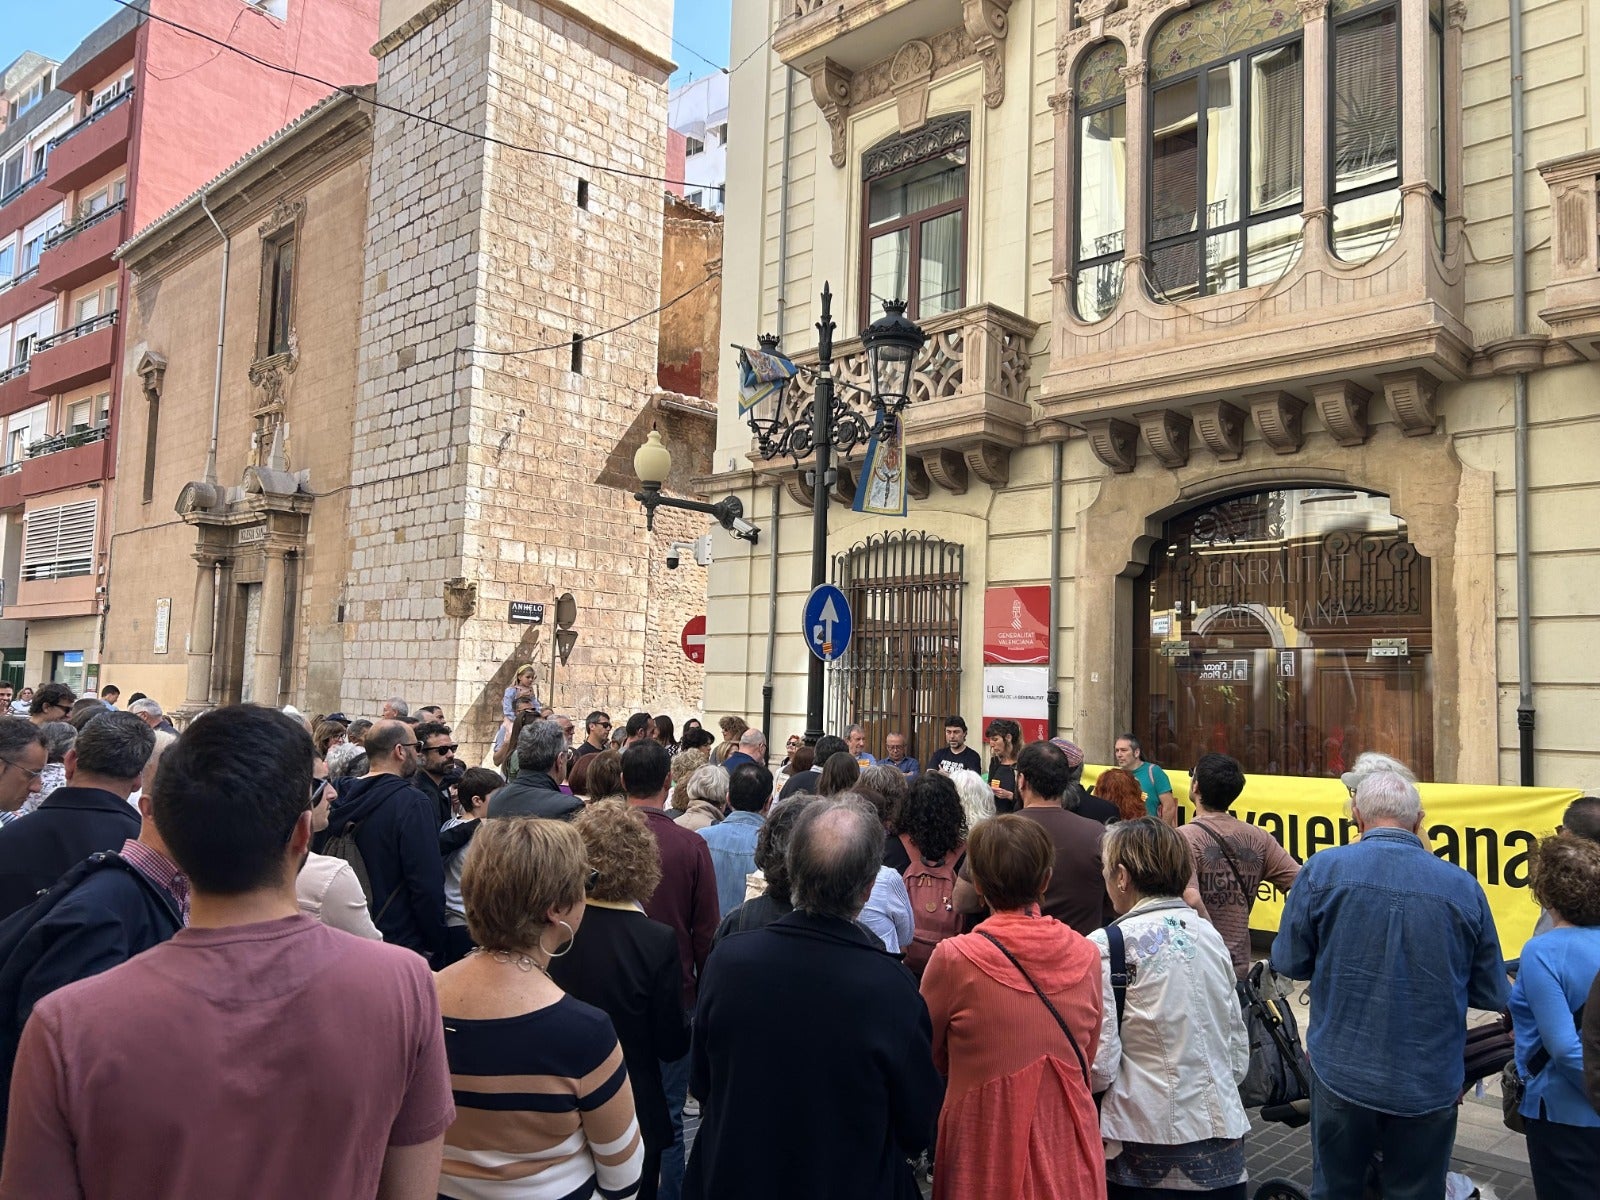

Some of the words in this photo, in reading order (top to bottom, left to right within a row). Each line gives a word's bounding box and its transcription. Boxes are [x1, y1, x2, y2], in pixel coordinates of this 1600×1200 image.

[1208, 554, 1351, 587] GENERALITAT
[512, 602, 543, 611] ANHELO
[1209, 599, 1350, 628] VALENCIANA
